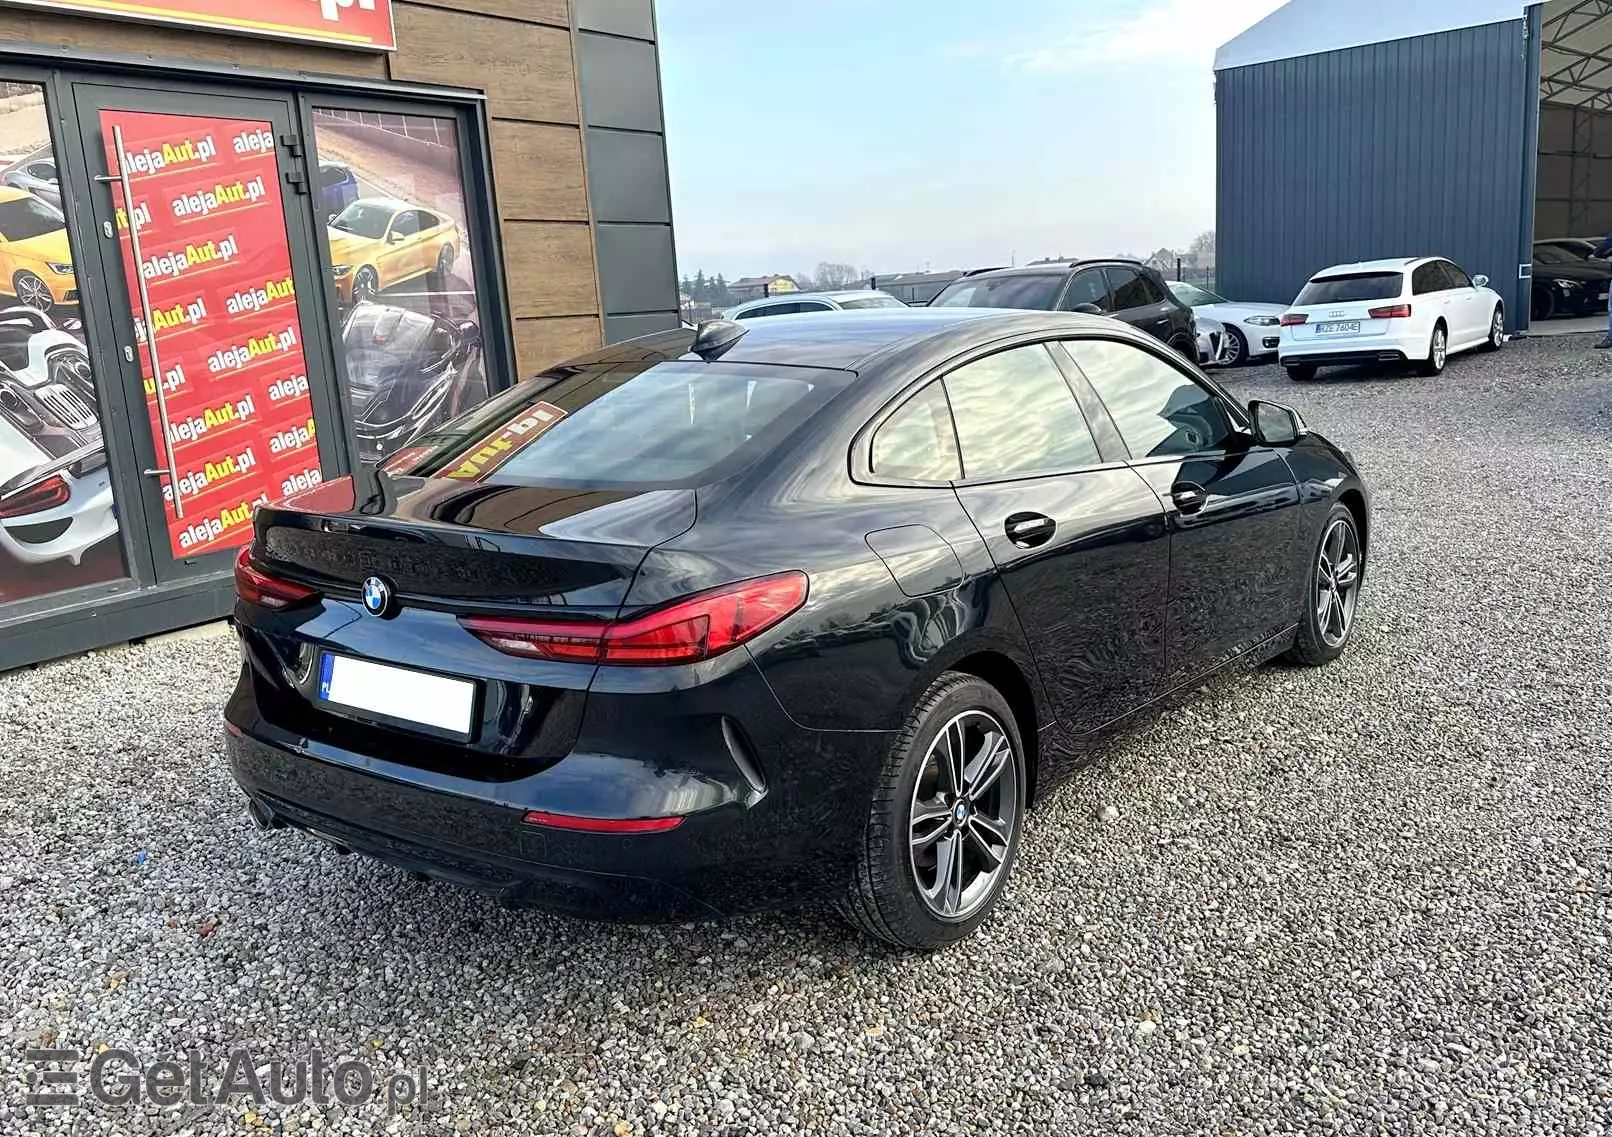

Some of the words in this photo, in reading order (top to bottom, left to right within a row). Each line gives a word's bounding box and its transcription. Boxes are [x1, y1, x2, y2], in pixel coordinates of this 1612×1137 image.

[125, 135, 216, 175] lejaAut.pl
[171, 175, 266, 215] alejaAut.pl
[142, 234, 239, 280] alejaAut.pl
[207, 326, 297, 373] alejaAut.pl
[168, 395, 255, 444] lejaAut.pl
[162, 447, 256, 501] aejaAut.pl
